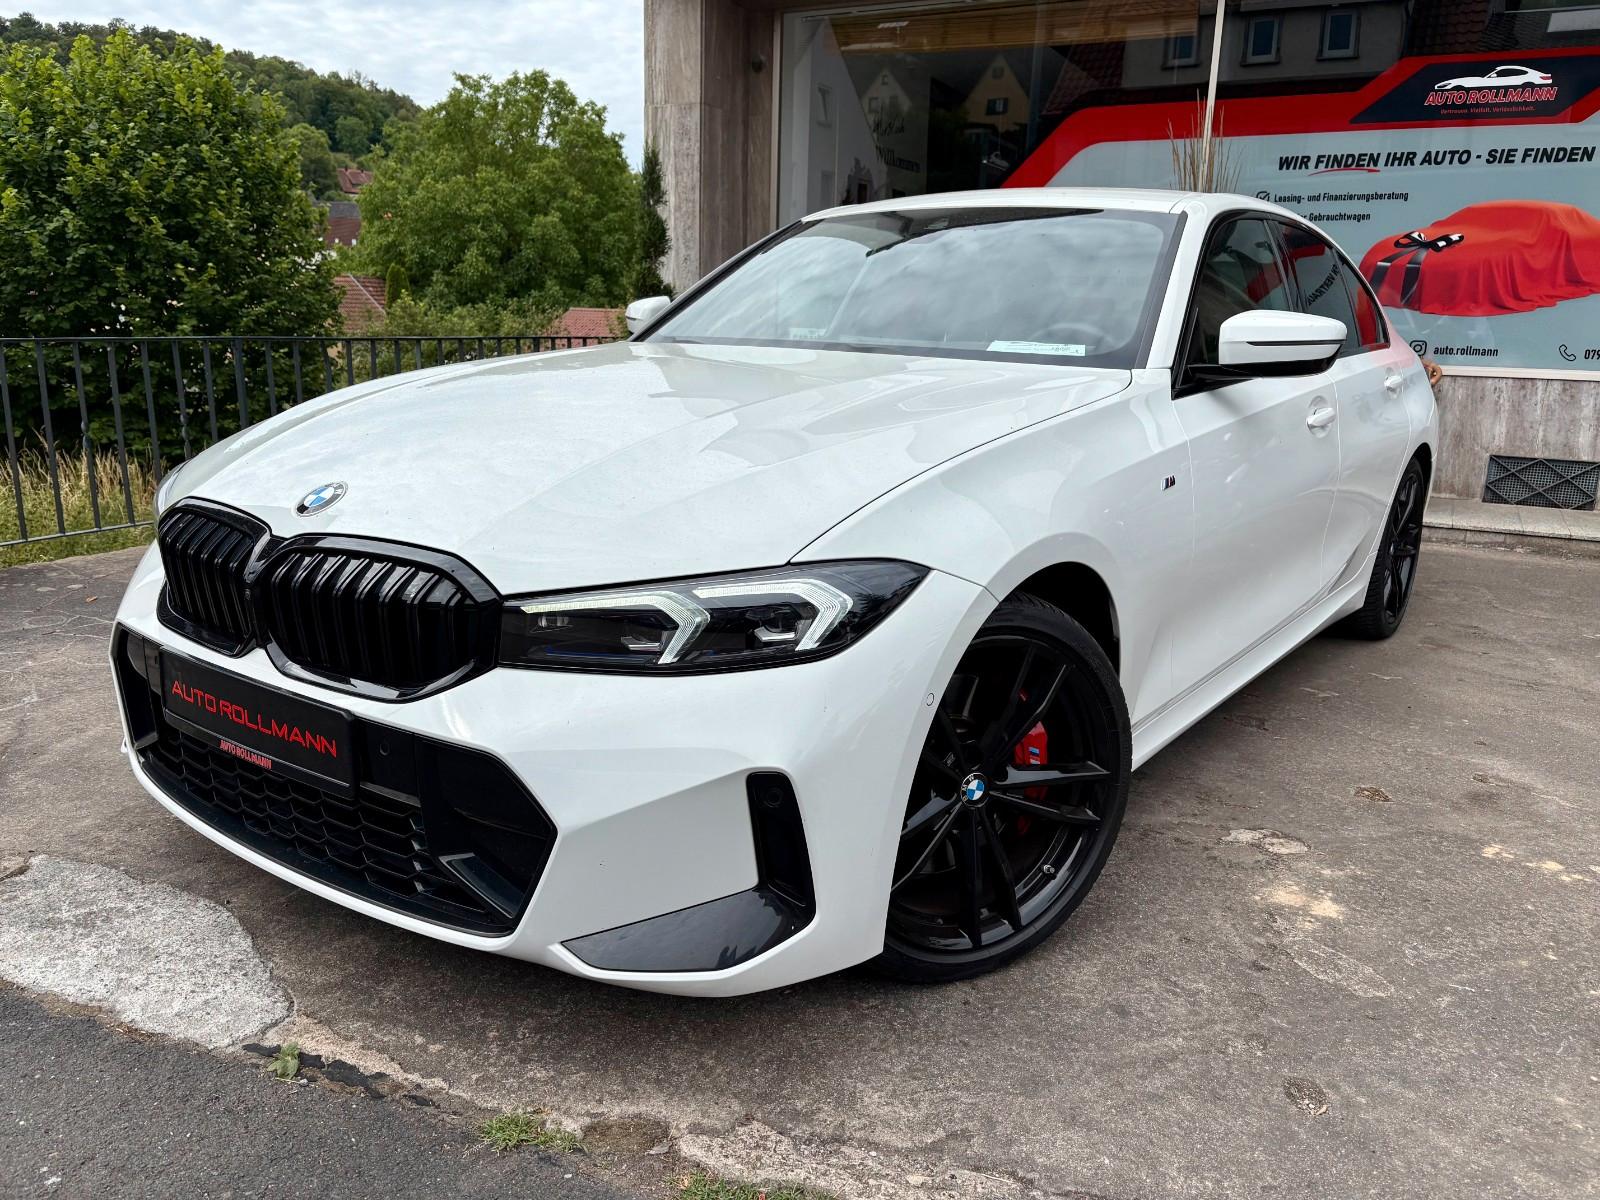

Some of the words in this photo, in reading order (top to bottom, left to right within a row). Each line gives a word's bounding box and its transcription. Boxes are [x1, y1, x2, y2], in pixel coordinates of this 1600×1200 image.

[1424, 90, 1467, 105] AUTO
[1467, 87, 1558, 103] ROLLMANN
[1278, 155, 1311, 170] WIR
[1314, 152, 1381, 169] FINDEN
[1384, 151, 1417, 167] IHR
[1420, 149, 1472, 166] AUTO
[1485, 148, 1518, 164] SIE
[1521, 146, 1596, 163] FINDEN
[1274, 193, 1305, 204] Leasing-
[1307, 193, 1321, 202] und
[1322, 191, 1409, 203] Finanzierungsberatung
[1308, 212, 1371, 222] Gebrauchtwagen
[1433, 345, 1499, 357] auto.rollmann
[171, 680, 217, 713] AUTO
[220, 699, 337, 759] ROLLMANN
[219, 739, 237, 755] AUTO
[236, 746, 272, 771] ROLLMANN
